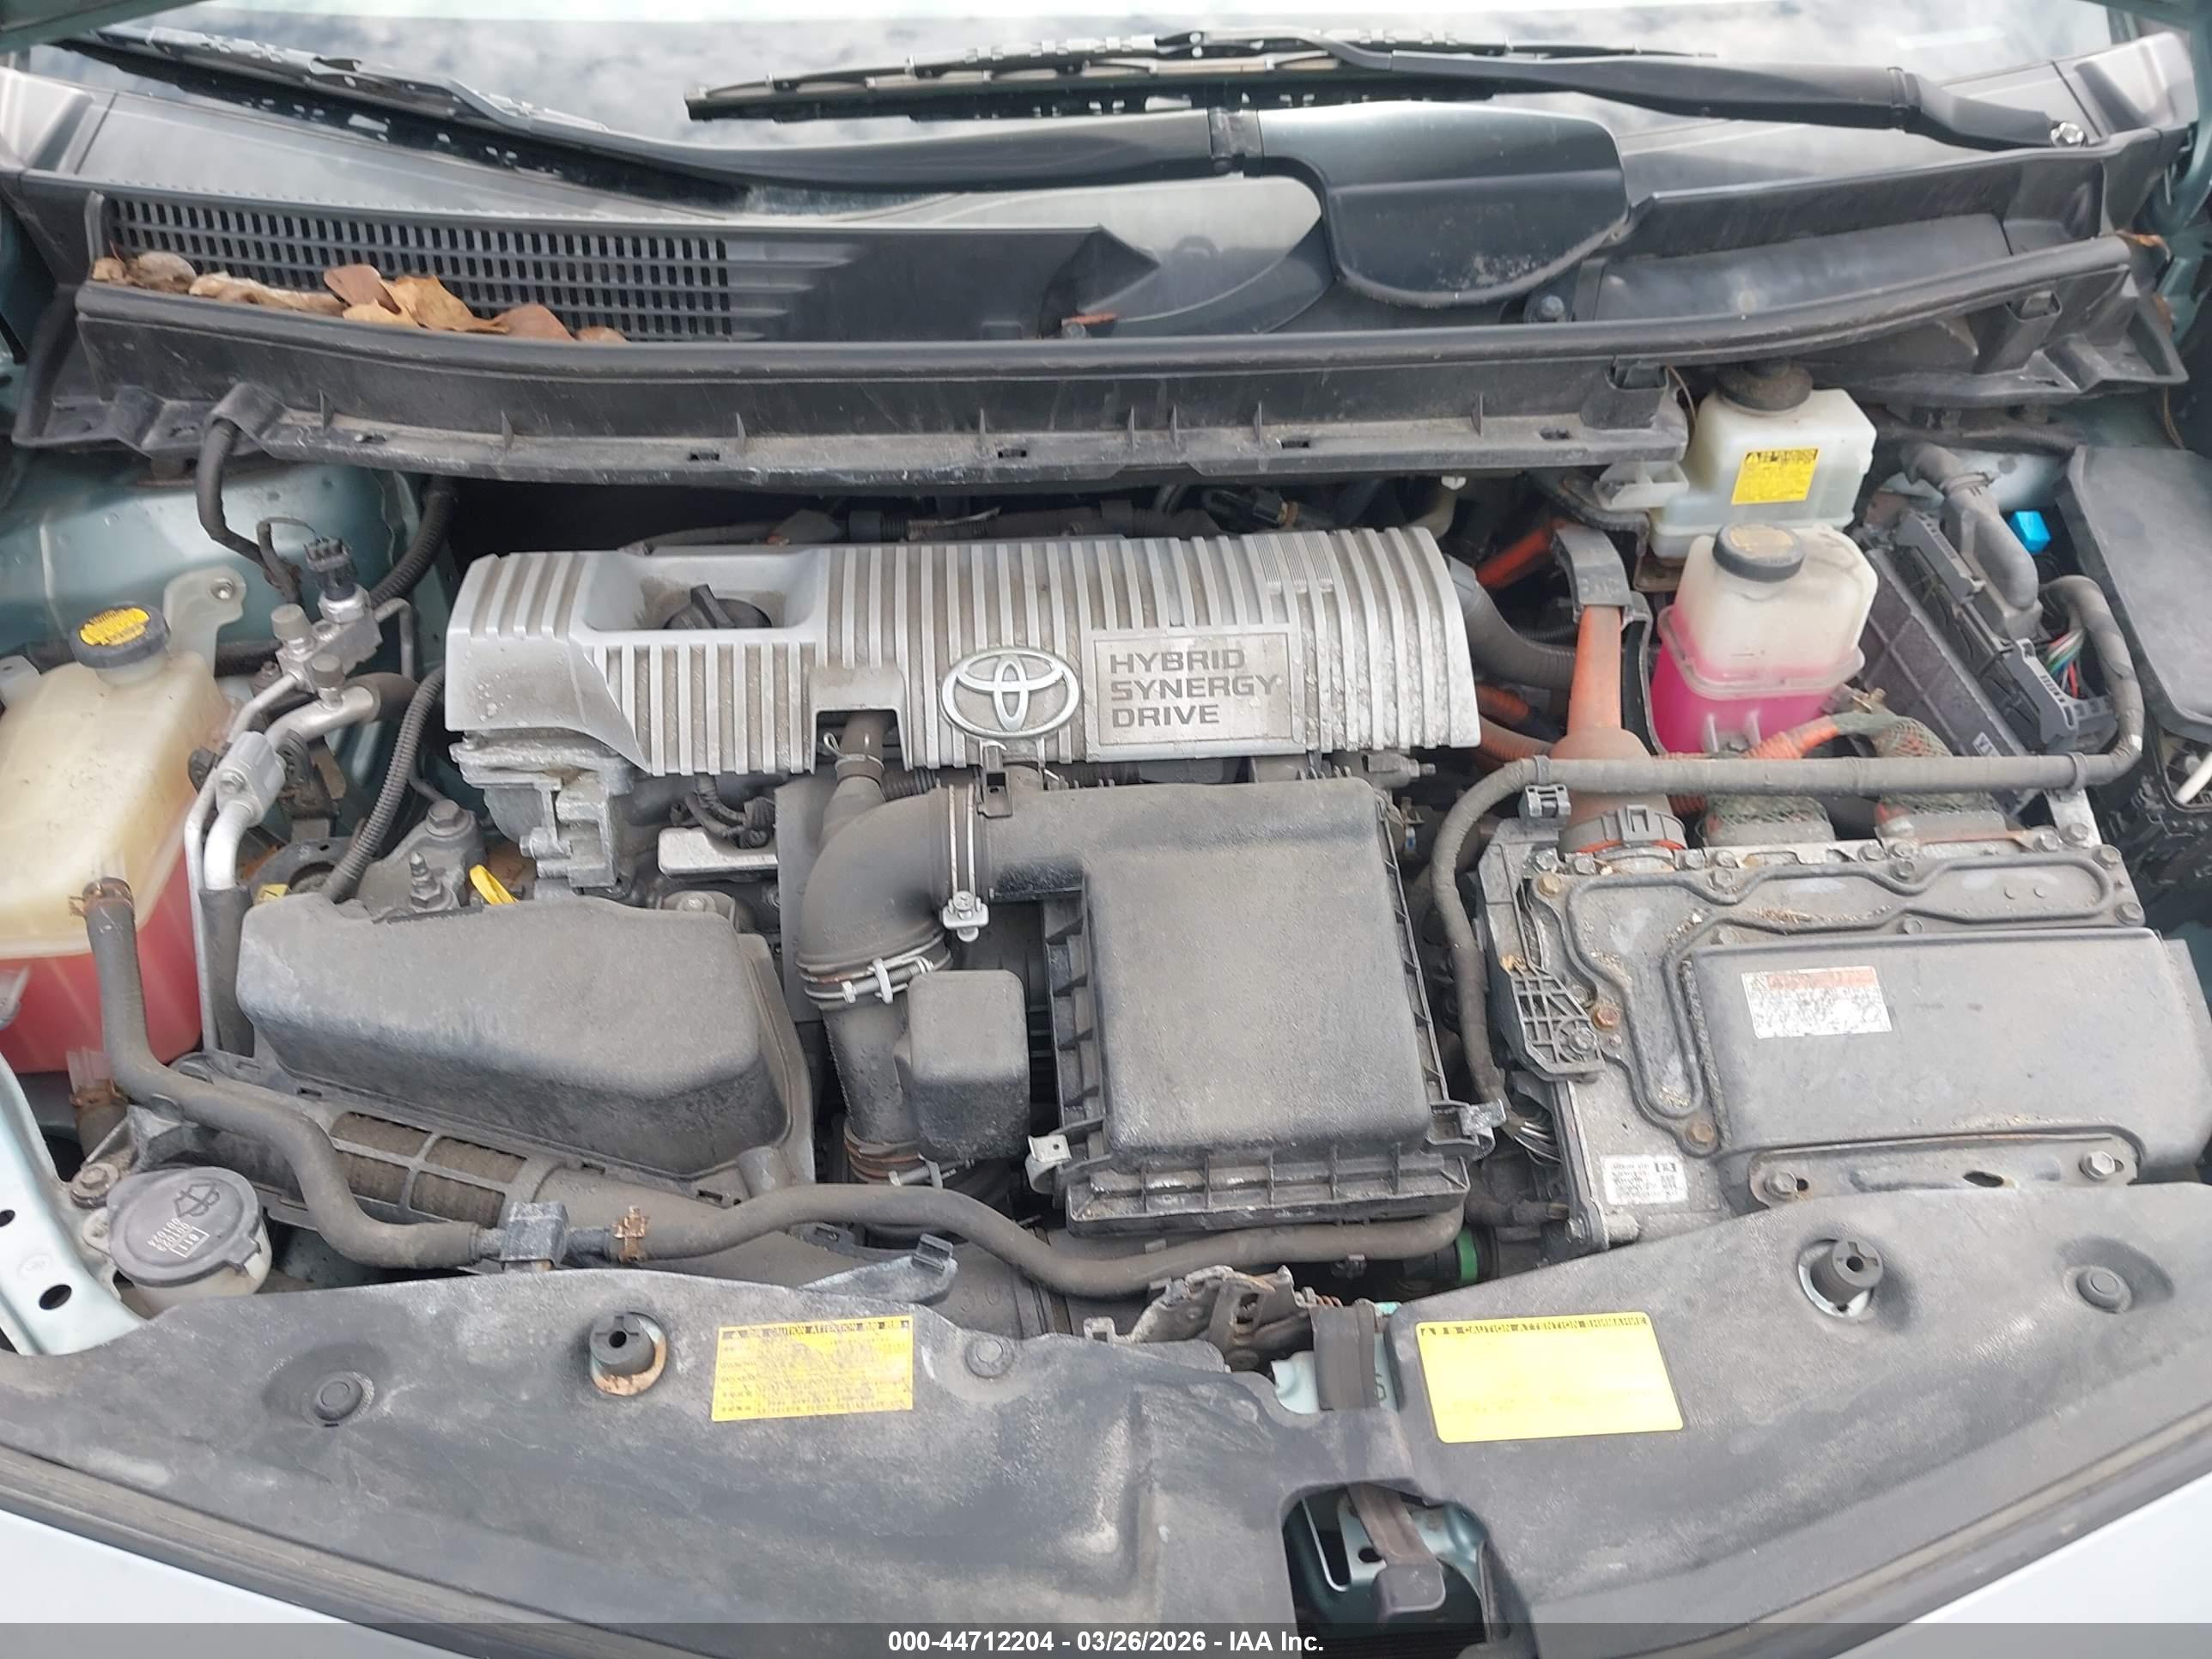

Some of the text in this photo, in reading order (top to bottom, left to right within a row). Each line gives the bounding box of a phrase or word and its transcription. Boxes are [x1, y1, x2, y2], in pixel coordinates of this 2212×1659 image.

[1110, 649, 1245, 673] HYBRID
[1111, 675, 1279, 701] SYNERGY
[1113, 704, 1219, 728] DRIVE
[1464, 1323, 1511, 1334] CAUTION
[1518, 1320, 1579, 1332] ATTENTION
